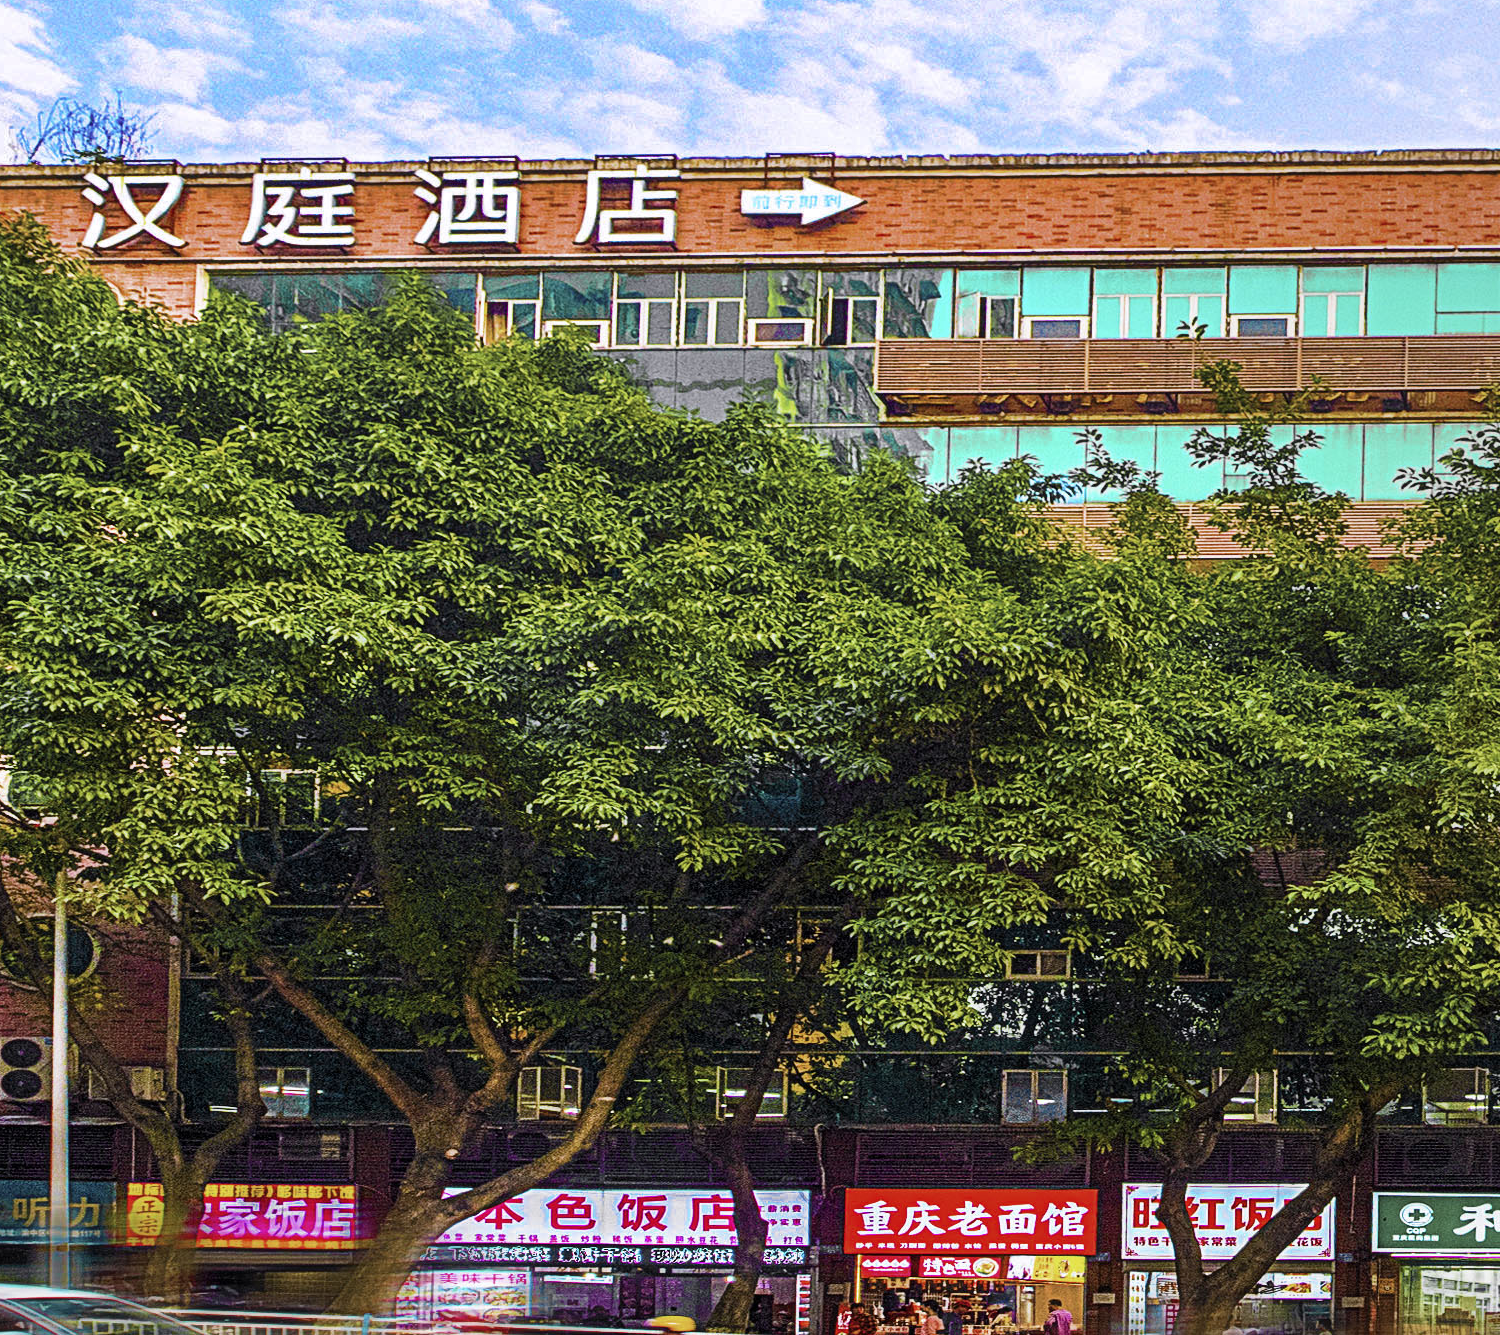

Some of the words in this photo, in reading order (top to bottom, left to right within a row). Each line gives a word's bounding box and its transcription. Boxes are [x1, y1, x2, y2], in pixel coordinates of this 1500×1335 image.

[81, 168, 681, 249] 汉庭酒店
[752, 194, 842, 210] 前行即到
[136, 1200, 161, 1233] 正宗
[474, 1193, 736, 1232] 本色饭店
[853, 1200, 1089, 1236] 重庆老面馆
[1133, 1196, 1322, 1231] 旺红饭
[440, 1273, 528, 1285] 美味干锅
